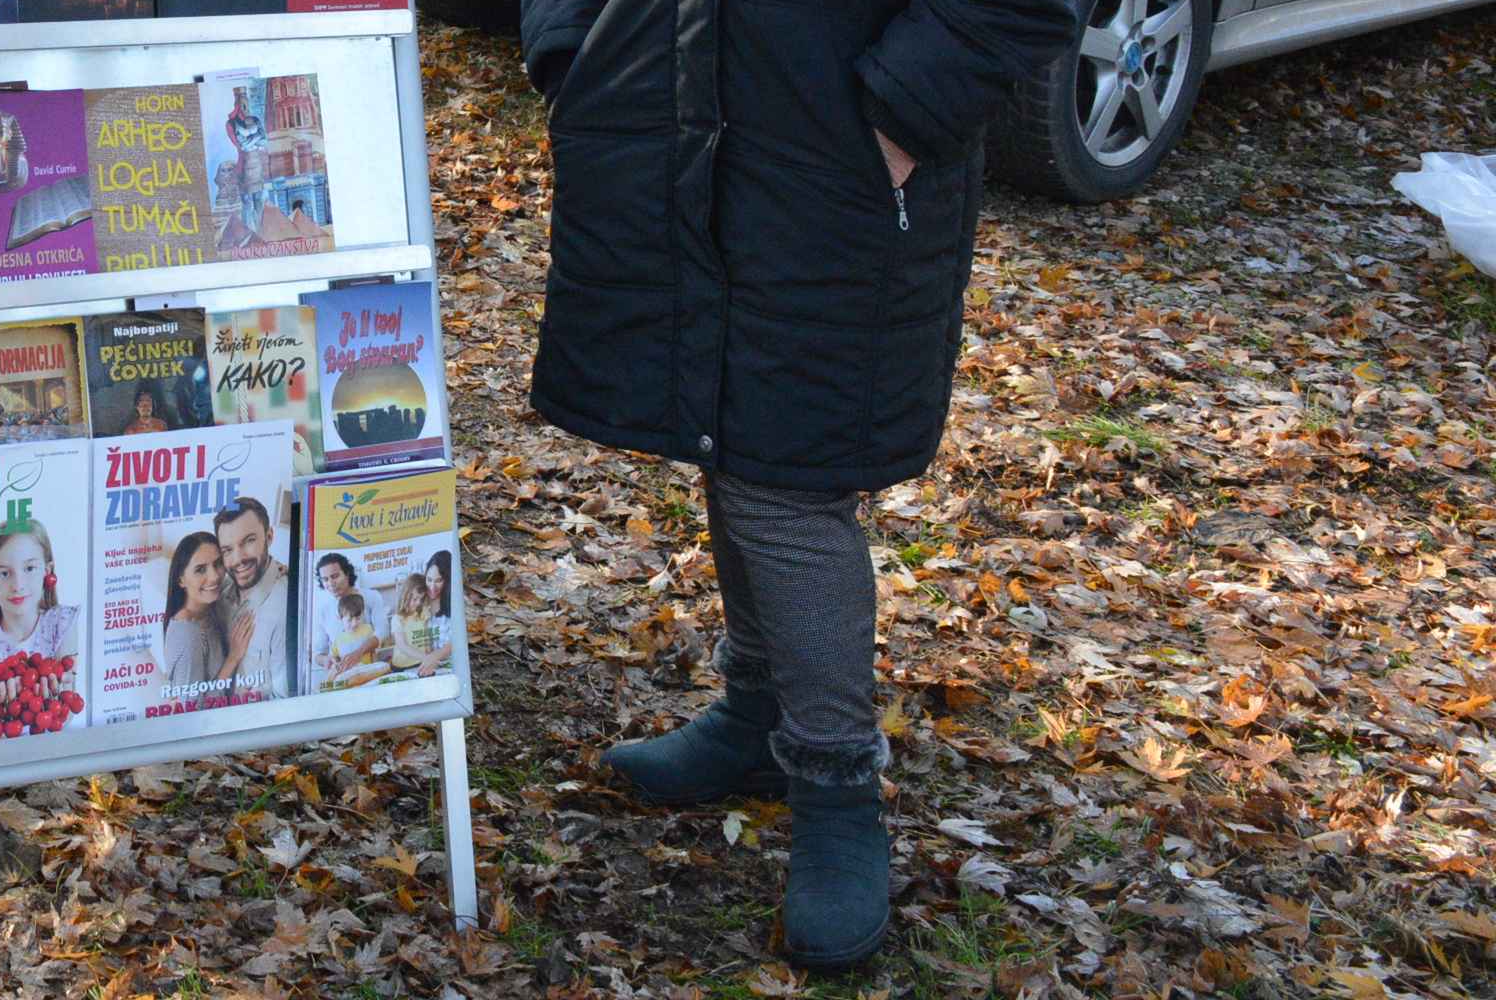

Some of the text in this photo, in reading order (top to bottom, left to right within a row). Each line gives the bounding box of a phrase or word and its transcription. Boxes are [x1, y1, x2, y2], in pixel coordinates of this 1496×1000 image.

[136, 94, 185, 113] HORN
[34, 165, 52, 176] David
[98, 159, 192, 196] LOGIJA
[102, 200, 200, 236] TUMAČI
[37, 244, 85, 265] OTKRIĆA
[113, 322, 179, 338] Najbogatiji
[101, 339, 194, 364] PEĆINSKI
[213, 330, 303, 360] Živjeti vjerom
[110, 359, 185, 382] ČOVJEK
[324, 344, 356, 377] Bog
[217, 357, 305, 392] KAKO?
[106, 445, 206, 488] ŽIVOT I
[105, 477, 241, 525] ZDRAVLJE
[379, 508, 384, 526] i
[388, 499, 439, 527] zdravlje
[104, 605, 140, 619] STROJ
[104, 612, 169, 630] ZAUSTAVI?
[104, 662, 155, 681] JAČI OD
[161, 670, 265, 698] Razgovor koji
[104, 679, 148, 692] COVIDA-19
